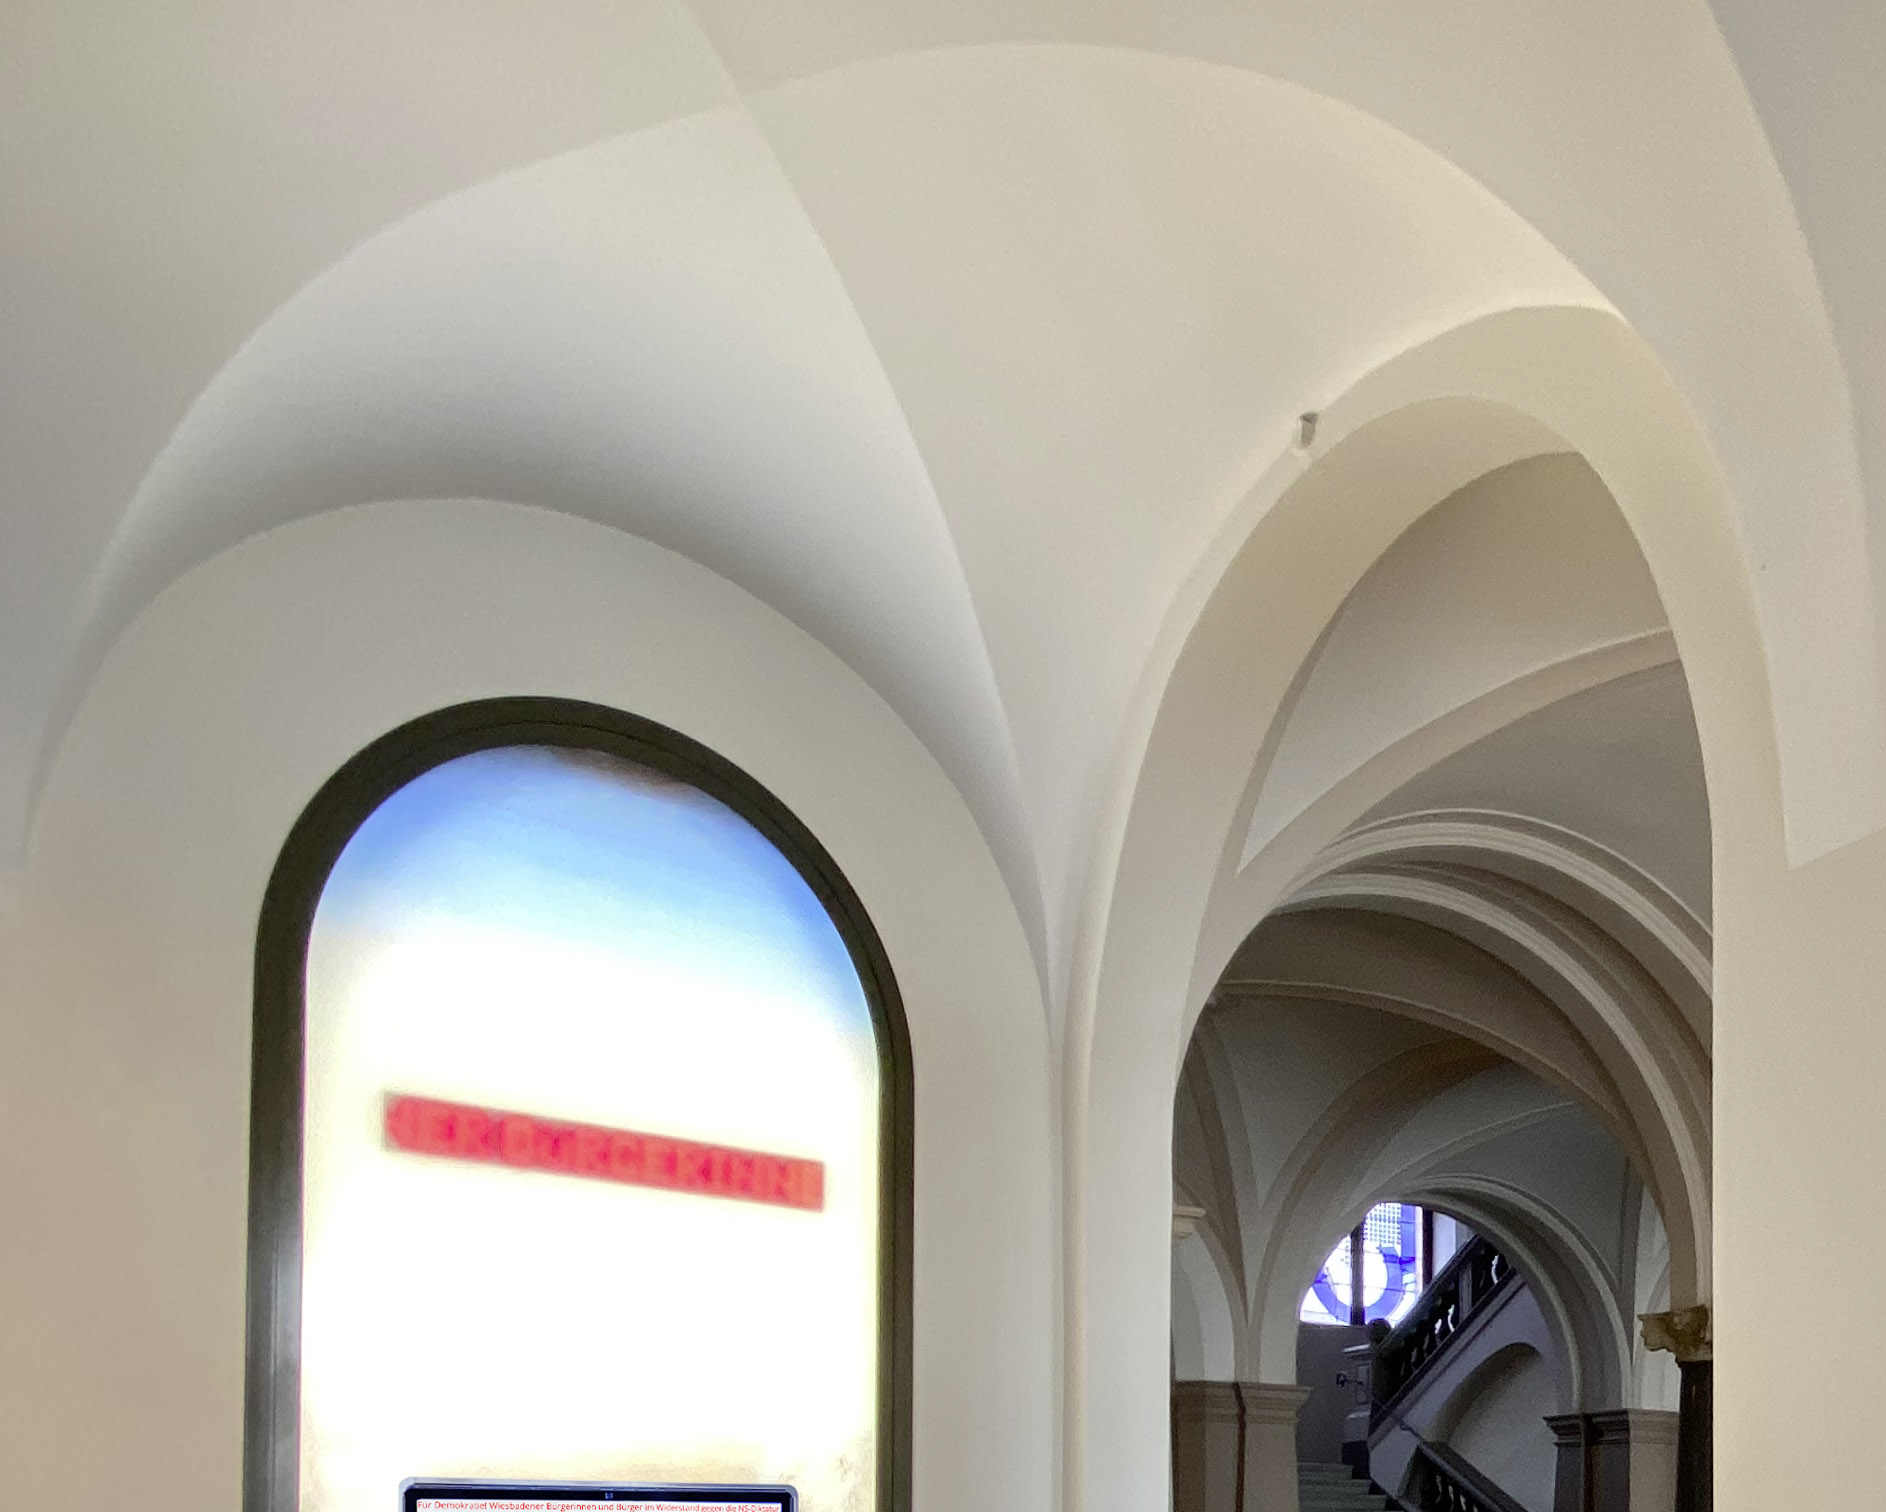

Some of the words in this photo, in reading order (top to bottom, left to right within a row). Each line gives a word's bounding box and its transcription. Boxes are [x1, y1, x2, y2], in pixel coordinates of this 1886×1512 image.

[417, 1501, 432, 1510] Für
[489, 1502, 544, 1510] Wiesbadener
[546, 1502, 597, 1512] Bürgerinnen
[599, 1503, 614, 1511] und
[616, 1502, 643, 1512] Bürger
[644, 1503, 655, 1511] im
[656, 1504, 700, 1512] Widerstand
[725, 1504, 737, 1512] die
[738, 1504, 780, 1512] NS-Diktatur
